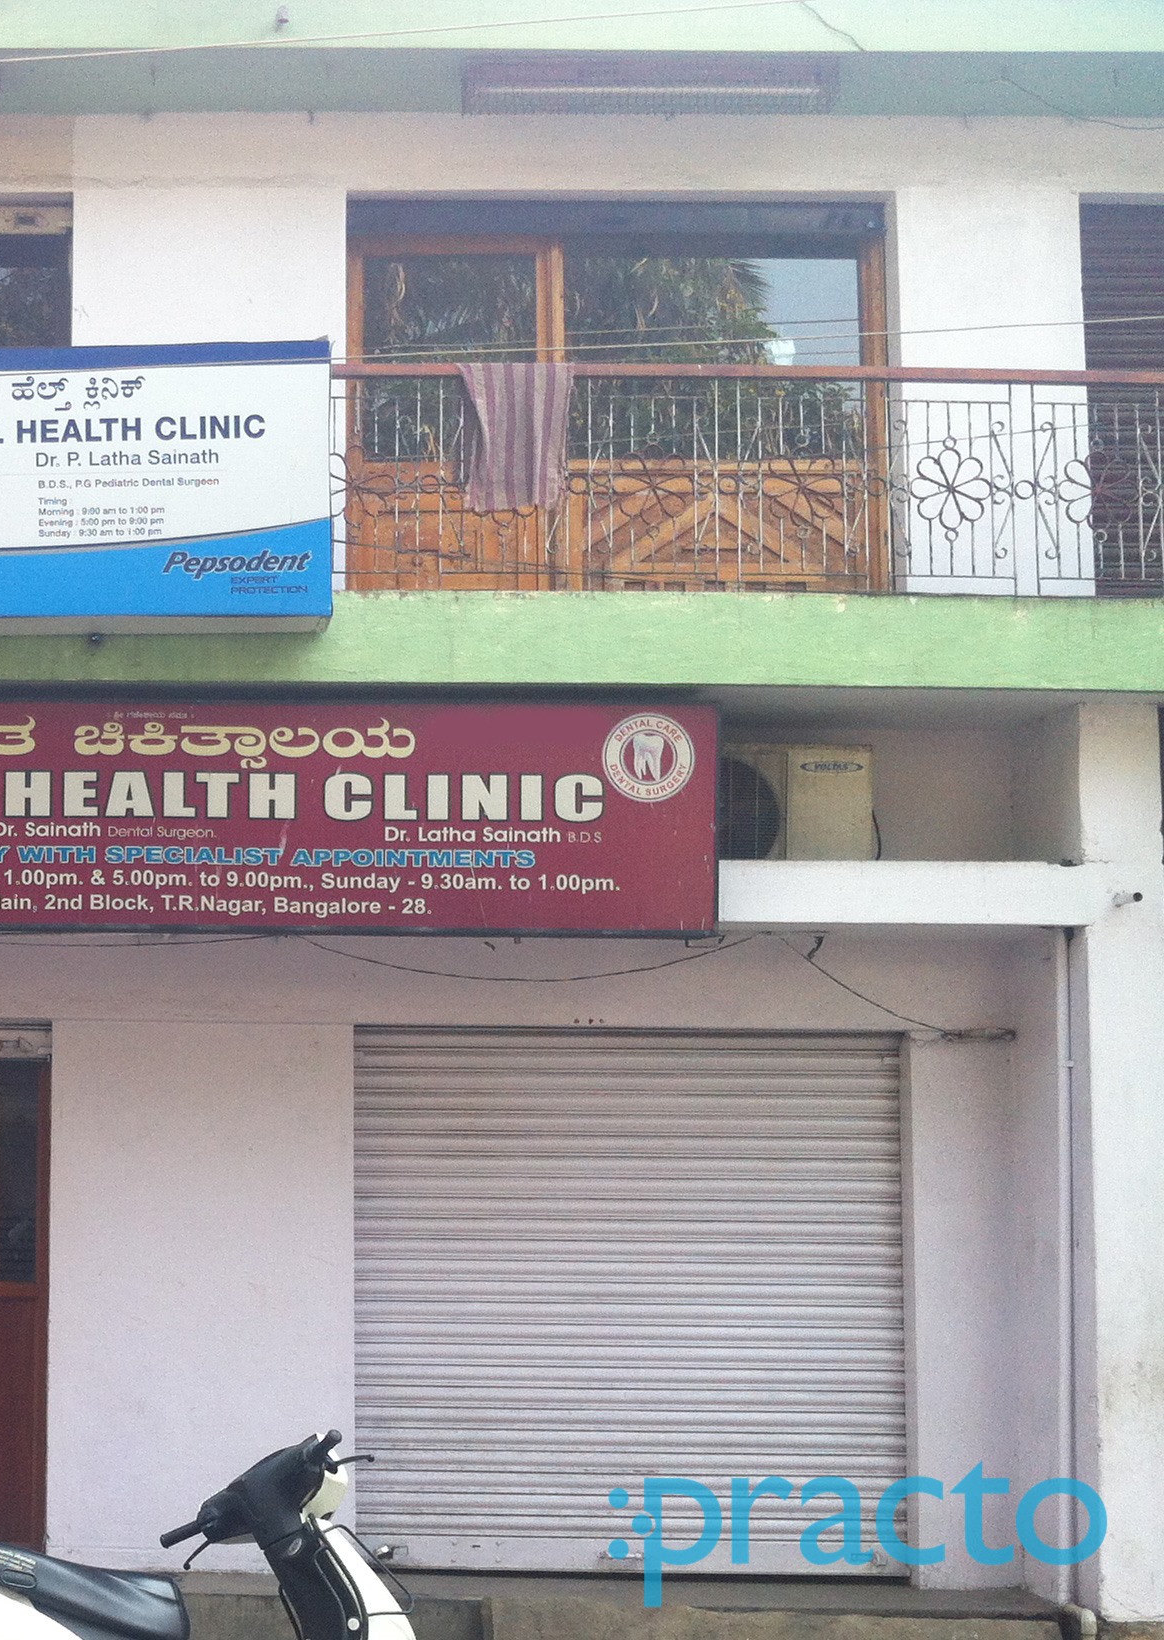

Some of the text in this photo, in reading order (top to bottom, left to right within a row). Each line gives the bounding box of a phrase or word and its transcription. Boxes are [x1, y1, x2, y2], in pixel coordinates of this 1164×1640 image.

[17, 418, 142, 443] HEALTH
[156, 414, 265, 440] CLINIC
[36, 449, 218, 467] Dr. P. Latha Sainath
[95, 479, 139, 487] Pediatric
[142, 478, 174, 486] Dental
[177, 478, 219, 486] Surgeon
[39, 498, 67, 506] Timing
[39, 508, 74, 517] Morning
[82, 507, 100, 515] 9:00
[130, 506, 148, 514] 1:00
[151, 507, 165, 515] pm
[39, 519, 73, 527] Evening
[39, 529, 71, 538] Sunday
[148, 529, 162, 537] pm
[162, 549, 311, 580] Pepsodent
[231, 576, 277, 584] EXPERT
[231, 586, 308, 594] PROTECTION
[614, 719, 683, 743] DENTAL CARE
[73, 718, 415, 769] ಚಿಕಿತ್ಸಾಲಯ
[610, 764, 686, 796] DENTAL SURGERY
[5, 770, 296, 819] HEALTH
[324, 773, 604, 822] CLINIC
[25, 821, 100, 837] Sainath
[108, 826, 153, 837] Dental
[385, 827, 411, 842] Dr.
[418, 827, 476, 842] Latha
[483, 826, 561, 842] Sainath
[19, 846, 97, 864] WITH
[105, 846, 283, 866] SPECIALIST
[290, 848, 535, 867] APPOINTMENTS
[4, 870, 83, 890] 1.00pm.
[91, 870, 105, 886] &
[113, 870, 192, 890] 5.00pm.
[200, 871, 220, 887] to
[321, 872, 400, 892] Sunday
[422, 874, 502, 891] 9.30am.
[509, 874, 530, 890] to
[538, 874, 620, 895] 1.00pm.
[45, 895, 82, 911] 2nd
[90, 895, 154, 912] Block,
[274, 897, 381, 918] Bangalore
